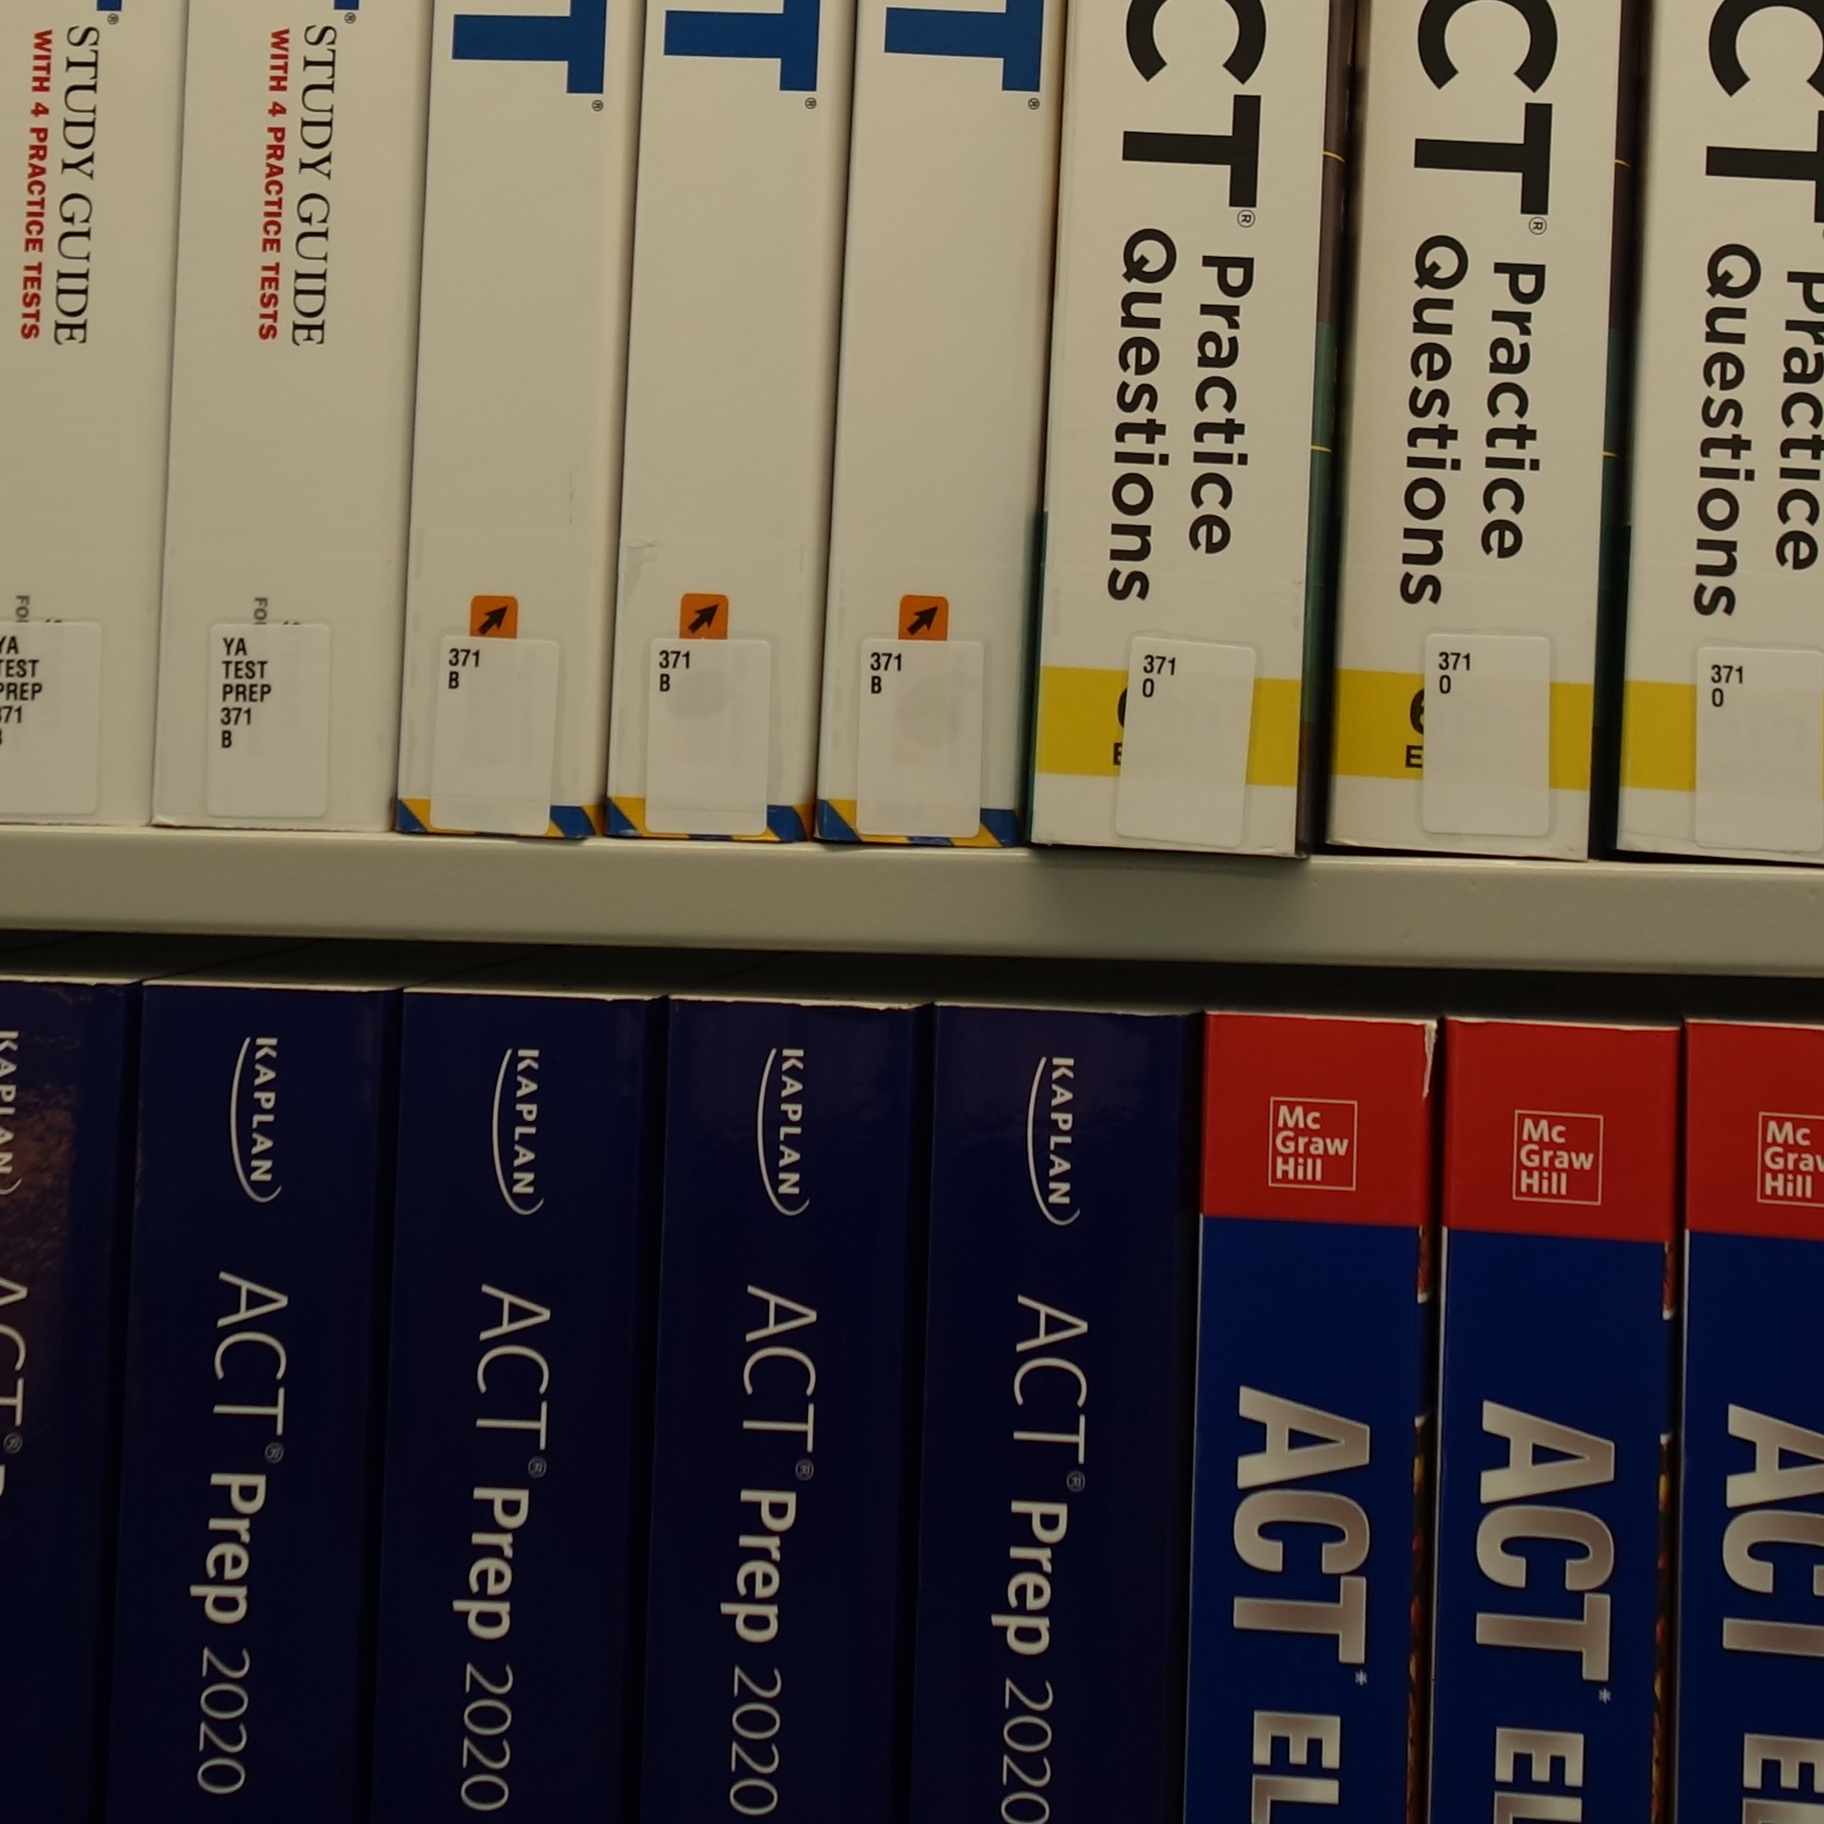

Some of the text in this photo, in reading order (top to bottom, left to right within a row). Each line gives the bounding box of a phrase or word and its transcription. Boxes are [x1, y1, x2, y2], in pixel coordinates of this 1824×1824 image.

[1107, 228, 1177, 601] Questions
[1188, 255, 1255, 555] Practice
[448, 647, 481, 668] 371
[1142, 653, 1176, 676] 371
[448, 670, 460, 690] B
[250, 1037, 278, 1182] KAPLAN
[1271, 1099, 1328, 1136] Mc
[1275, 1130, 1349, 1156] Graw
[1270, 1149, 1329, 1187] Hill
[189, 1473, 267, 1795] Prep 2020
